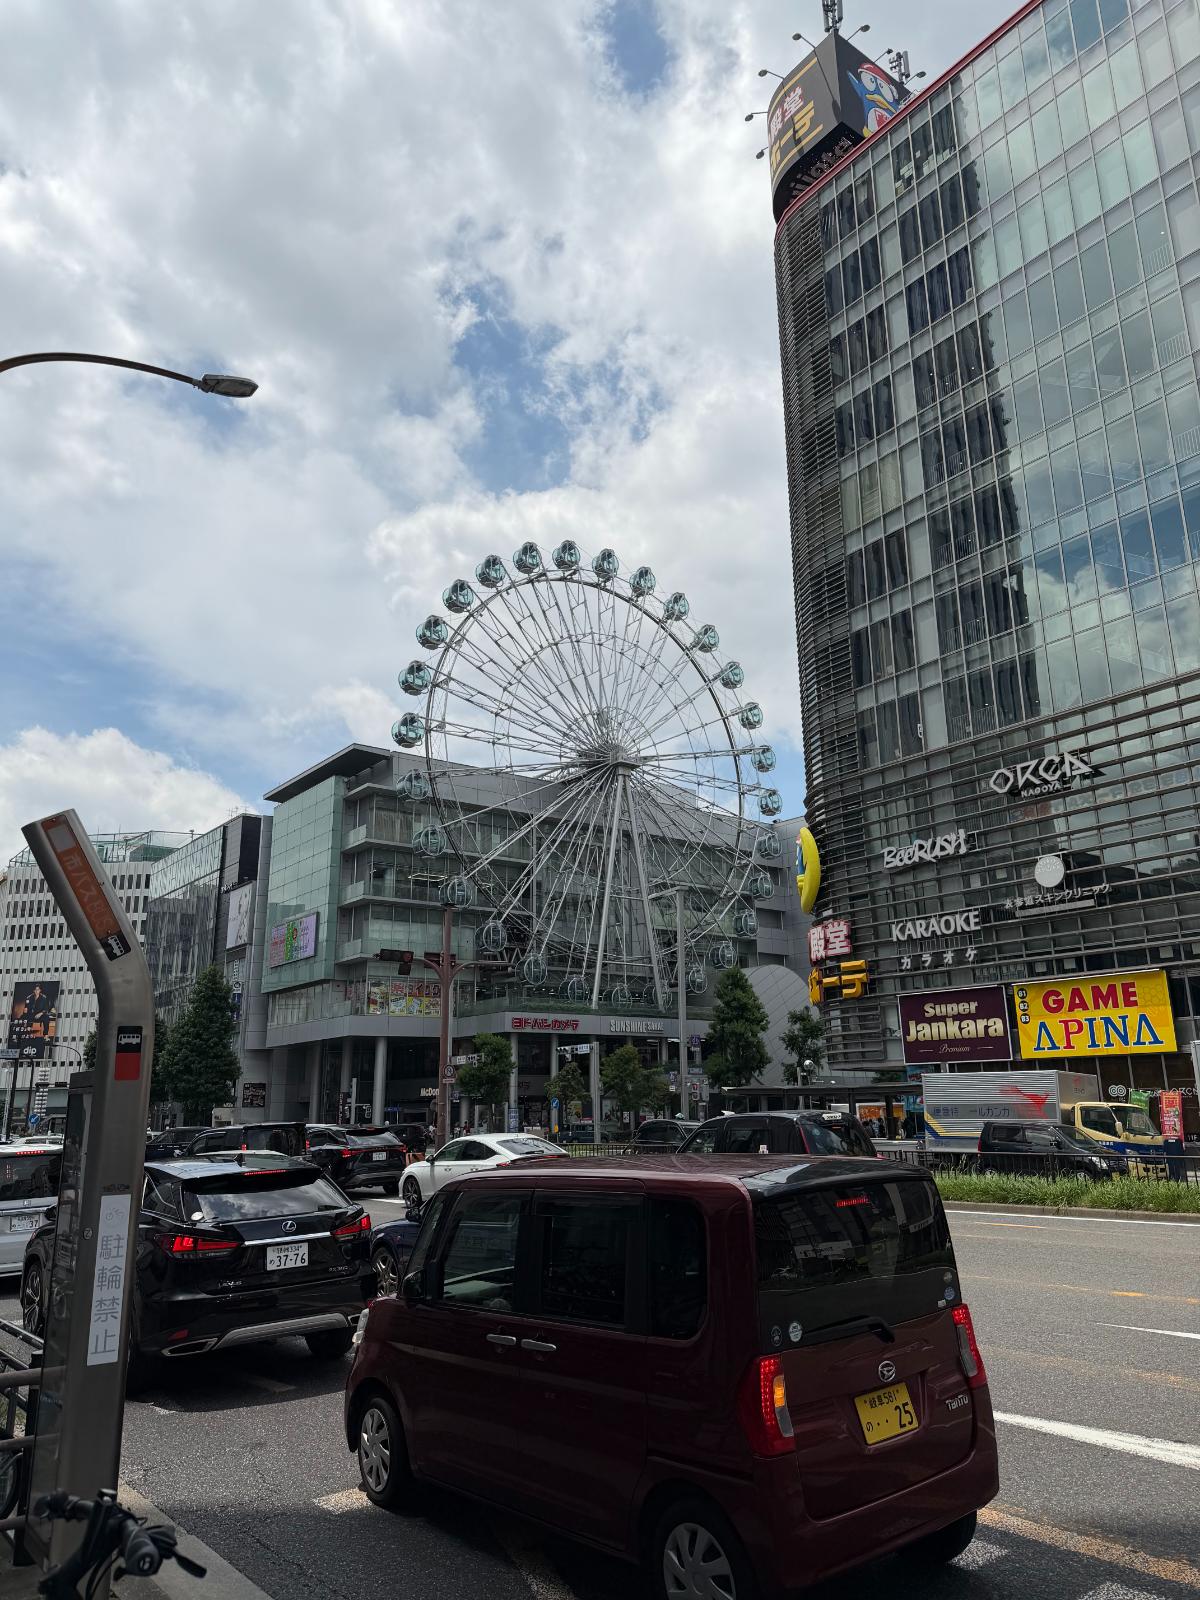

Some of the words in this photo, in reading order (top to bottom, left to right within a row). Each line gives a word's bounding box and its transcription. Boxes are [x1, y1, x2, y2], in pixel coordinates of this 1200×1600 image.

[990, 751, 1095, 794] ORCA
[1020, 781, 1061, 797] NAGOYA
[892, 910, 981, 942] KARAOKE
[808, 919, 852, 962] 殿堂
[900, 946, 977, 970] カラオケ
[1018, 989, 1026, 997] B1
[1042, 981, 1139, 1014] GAME
[923, 1001, 978, 1018] Super
[610, 1019, 647, 1033] SUNSHINE
[906, 1018, 1005, 1042] Jankara
[23, 1046, 37, 1056] dip
[938, 1043, 971, 1054] Premium
[420, 1087, 440, 1097] McDon
[276, 1252, 306, 1268] 37-76
[90, 1233, 125, 1355] 駐輪禁止
